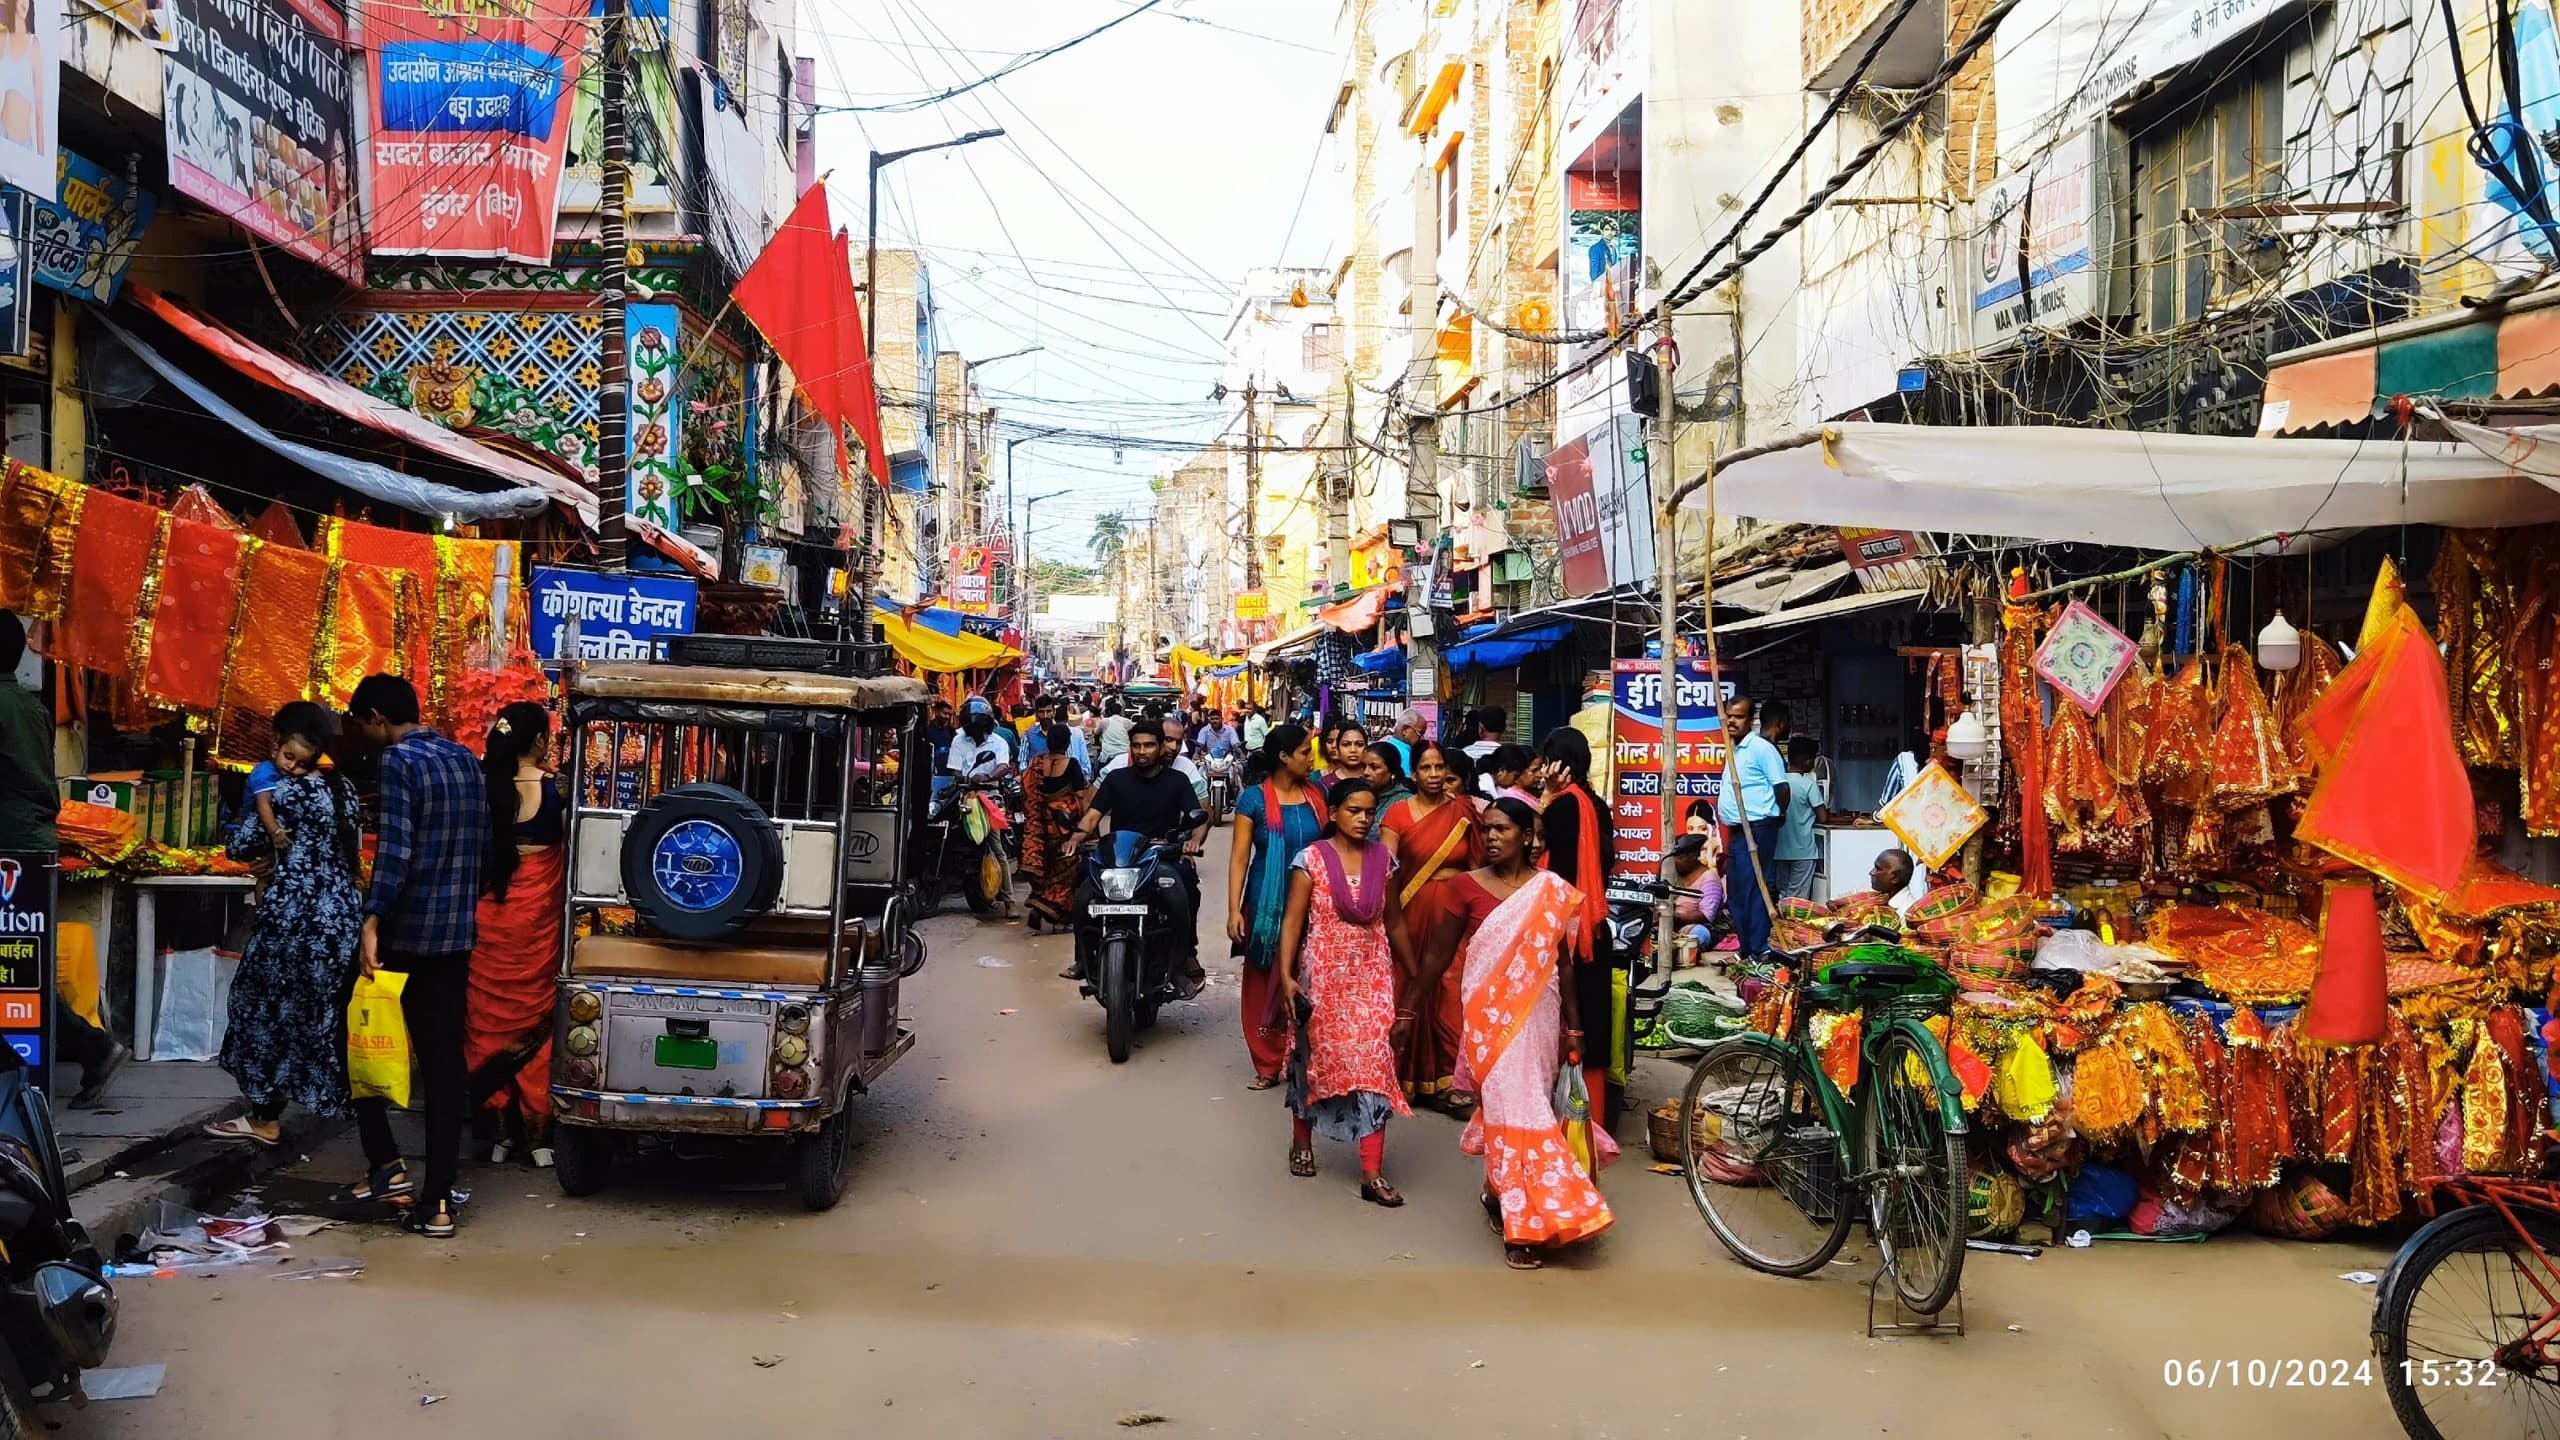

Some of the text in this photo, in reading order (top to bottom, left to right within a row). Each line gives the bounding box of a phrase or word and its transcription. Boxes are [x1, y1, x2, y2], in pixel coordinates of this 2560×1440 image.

[2191, 8, 2202, 39] श्री
[388, 56, 440, 83] उदासीन
[449, 96, 473, 125] बड़ा
[376, 141, 425, 168] सदर
[419, 184, 470, 230] मुंगेर
[541, 580, 686, 629] कौशल्या डेन्टल
[1616, 735, 1649, 765] रोल्ड
[1621, 773, 1660, 795] गारंटी
[1691, 774, 1723, 795] ज्वेल
[1619, 802, 1642, 817] जैसे
[1619, 828, 1653, 840] पायल
